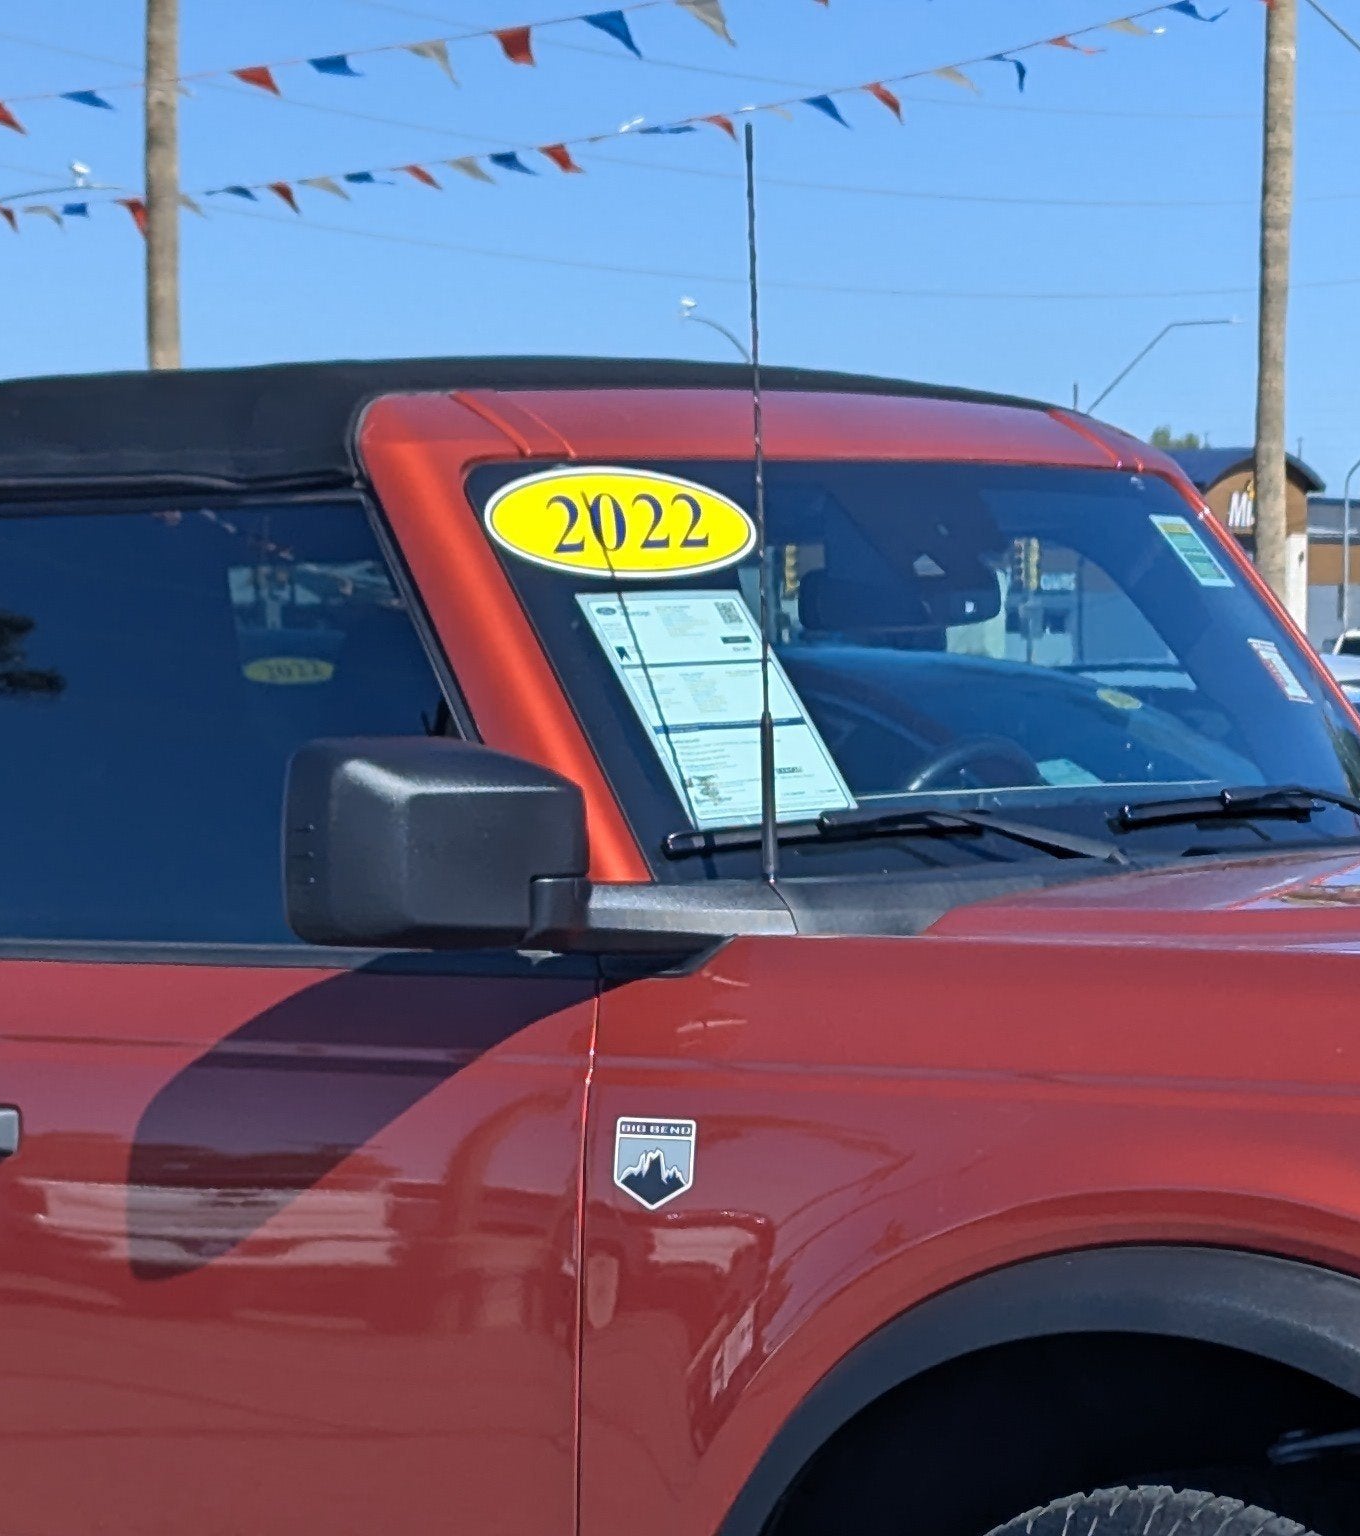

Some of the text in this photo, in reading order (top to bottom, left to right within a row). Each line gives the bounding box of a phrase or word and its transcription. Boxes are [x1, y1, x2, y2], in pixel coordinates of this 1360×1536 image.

[546, 493, 709, 554] 2022
[621, 1124, 691, 1135] BIG BEND
